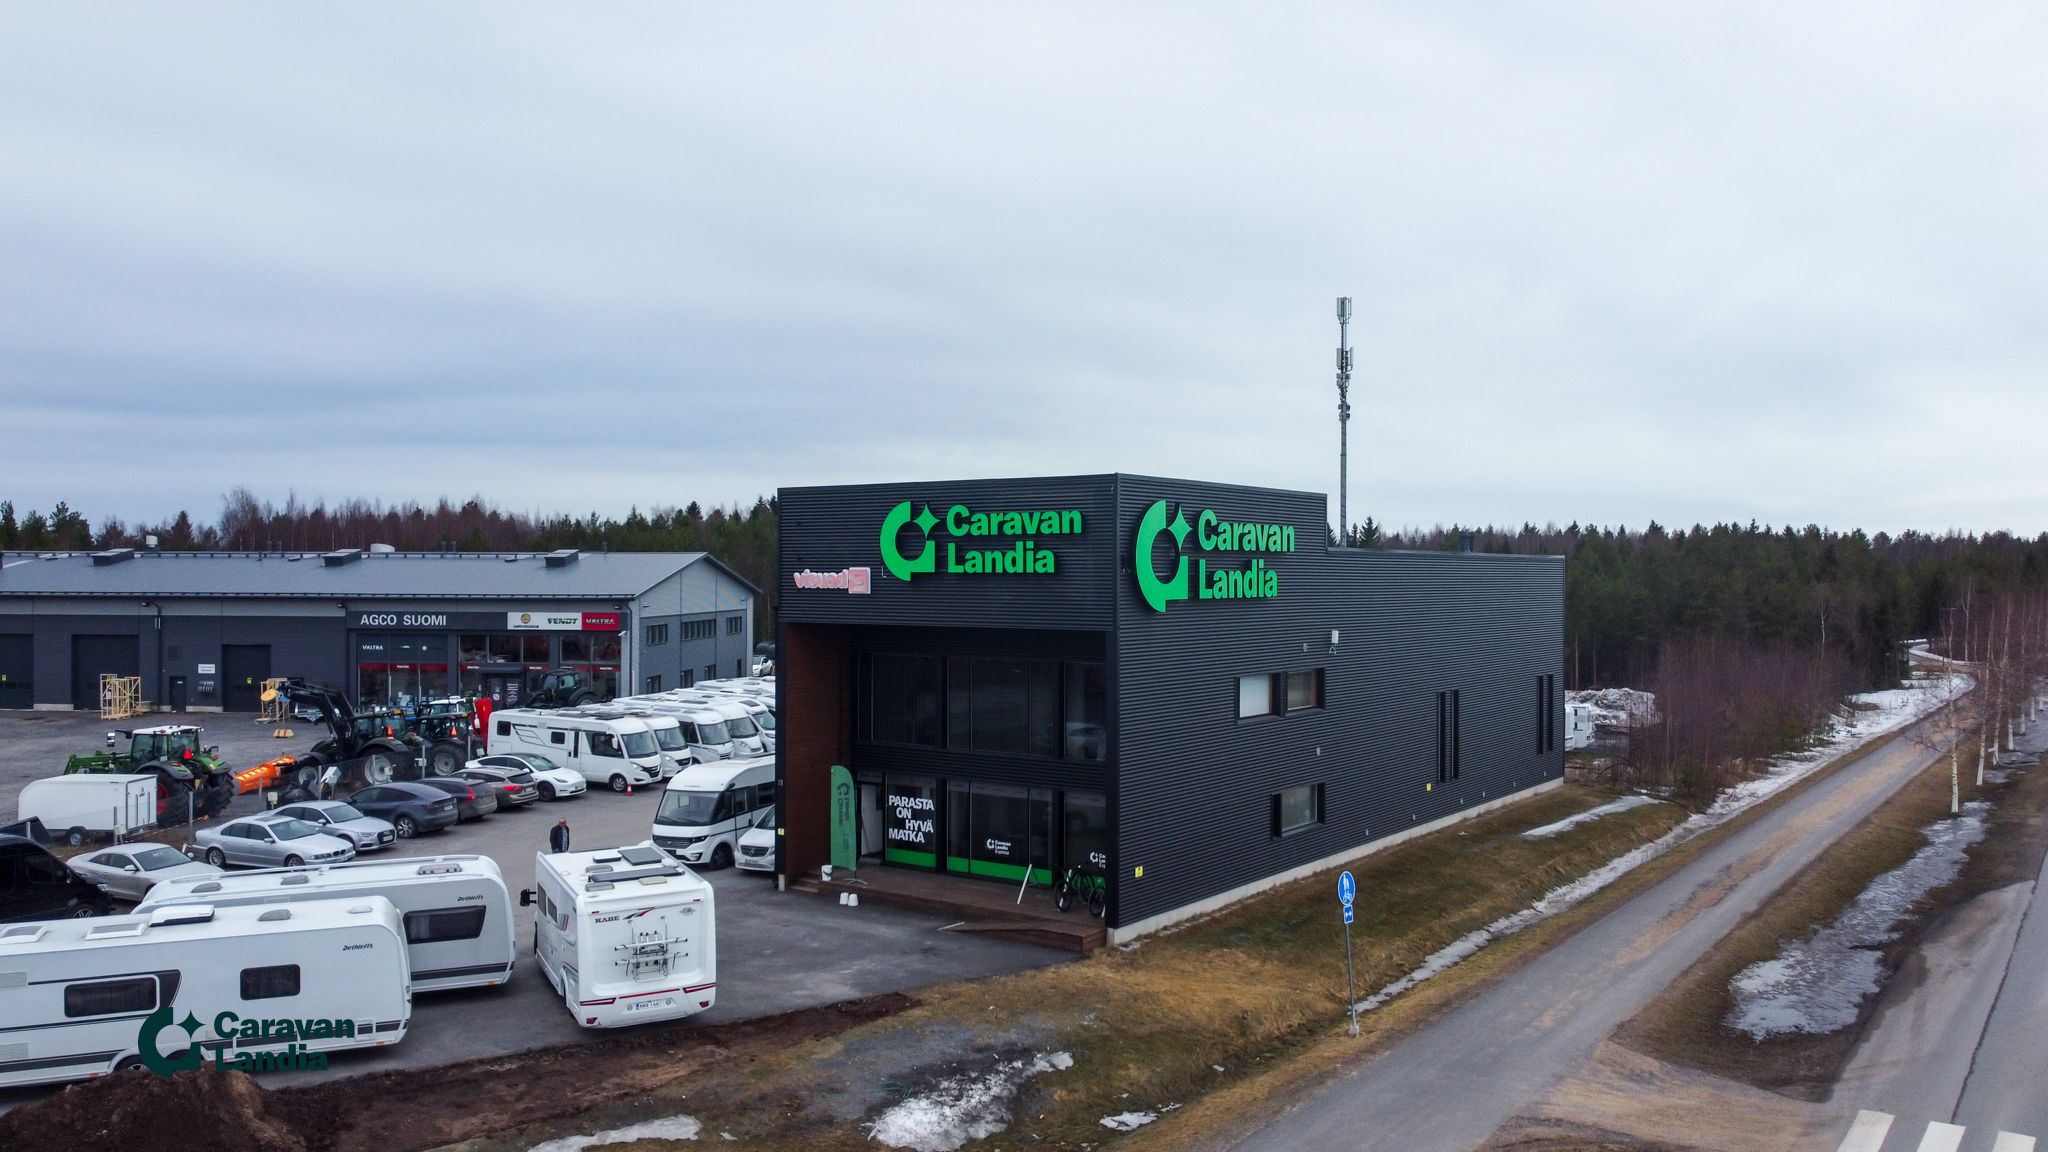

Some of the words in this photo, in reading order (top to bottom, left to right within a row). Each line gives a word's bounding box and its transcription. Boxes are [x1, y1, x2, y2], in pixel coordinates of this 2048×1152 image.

[946, 504, 1083, 537] Caravan
[1198, 508, 1296, 552] Caravan
[947, 540, 1055, 574] Landia
[1198, 558, 1279, 600] Landia
[360, 614, 397, 626] AGCO
[403, 614, 447, 626] SUOMI
[888, 795, 935, 811] PARASTA
[896, 807, 912, 819] ON
[905, 819, 934, 833] HYVÄ
[888, 828, 925, 844] MATKA
[594, 915, 620, 924] KABE
